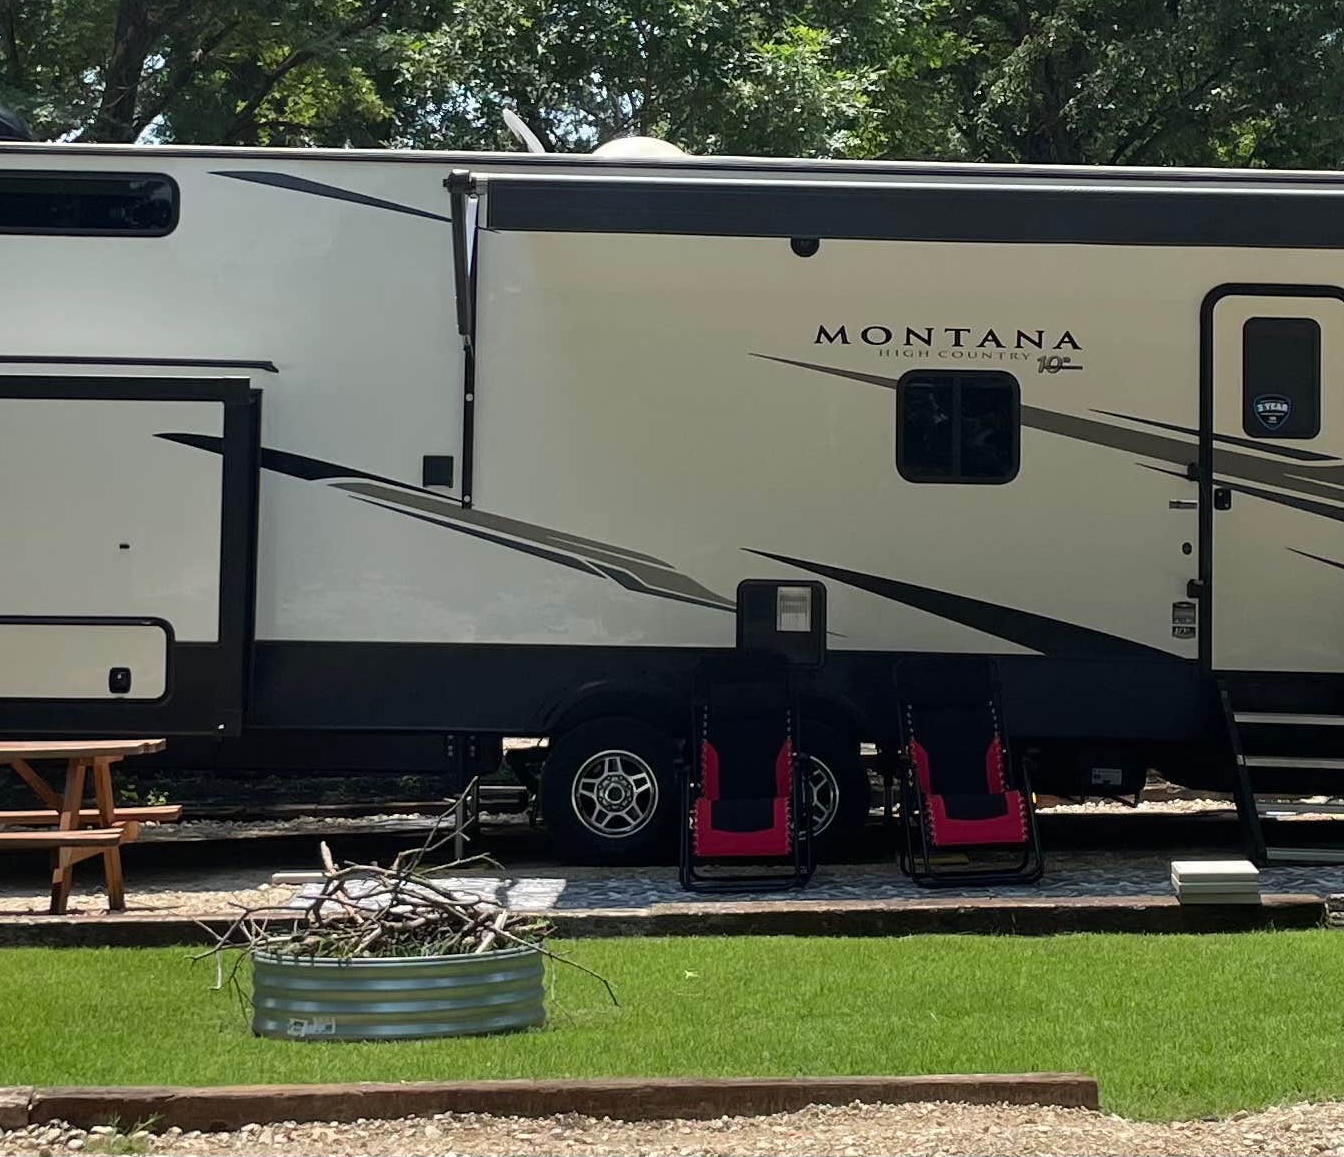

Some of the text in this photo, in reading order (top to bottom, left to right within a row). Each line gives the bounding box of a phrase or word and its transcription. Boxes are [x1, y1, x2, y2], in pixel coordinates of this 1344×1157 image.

[814, 324, 1083, 350] MONTANA
[879, 349, 1031, 361] HIGH COUNTRY
